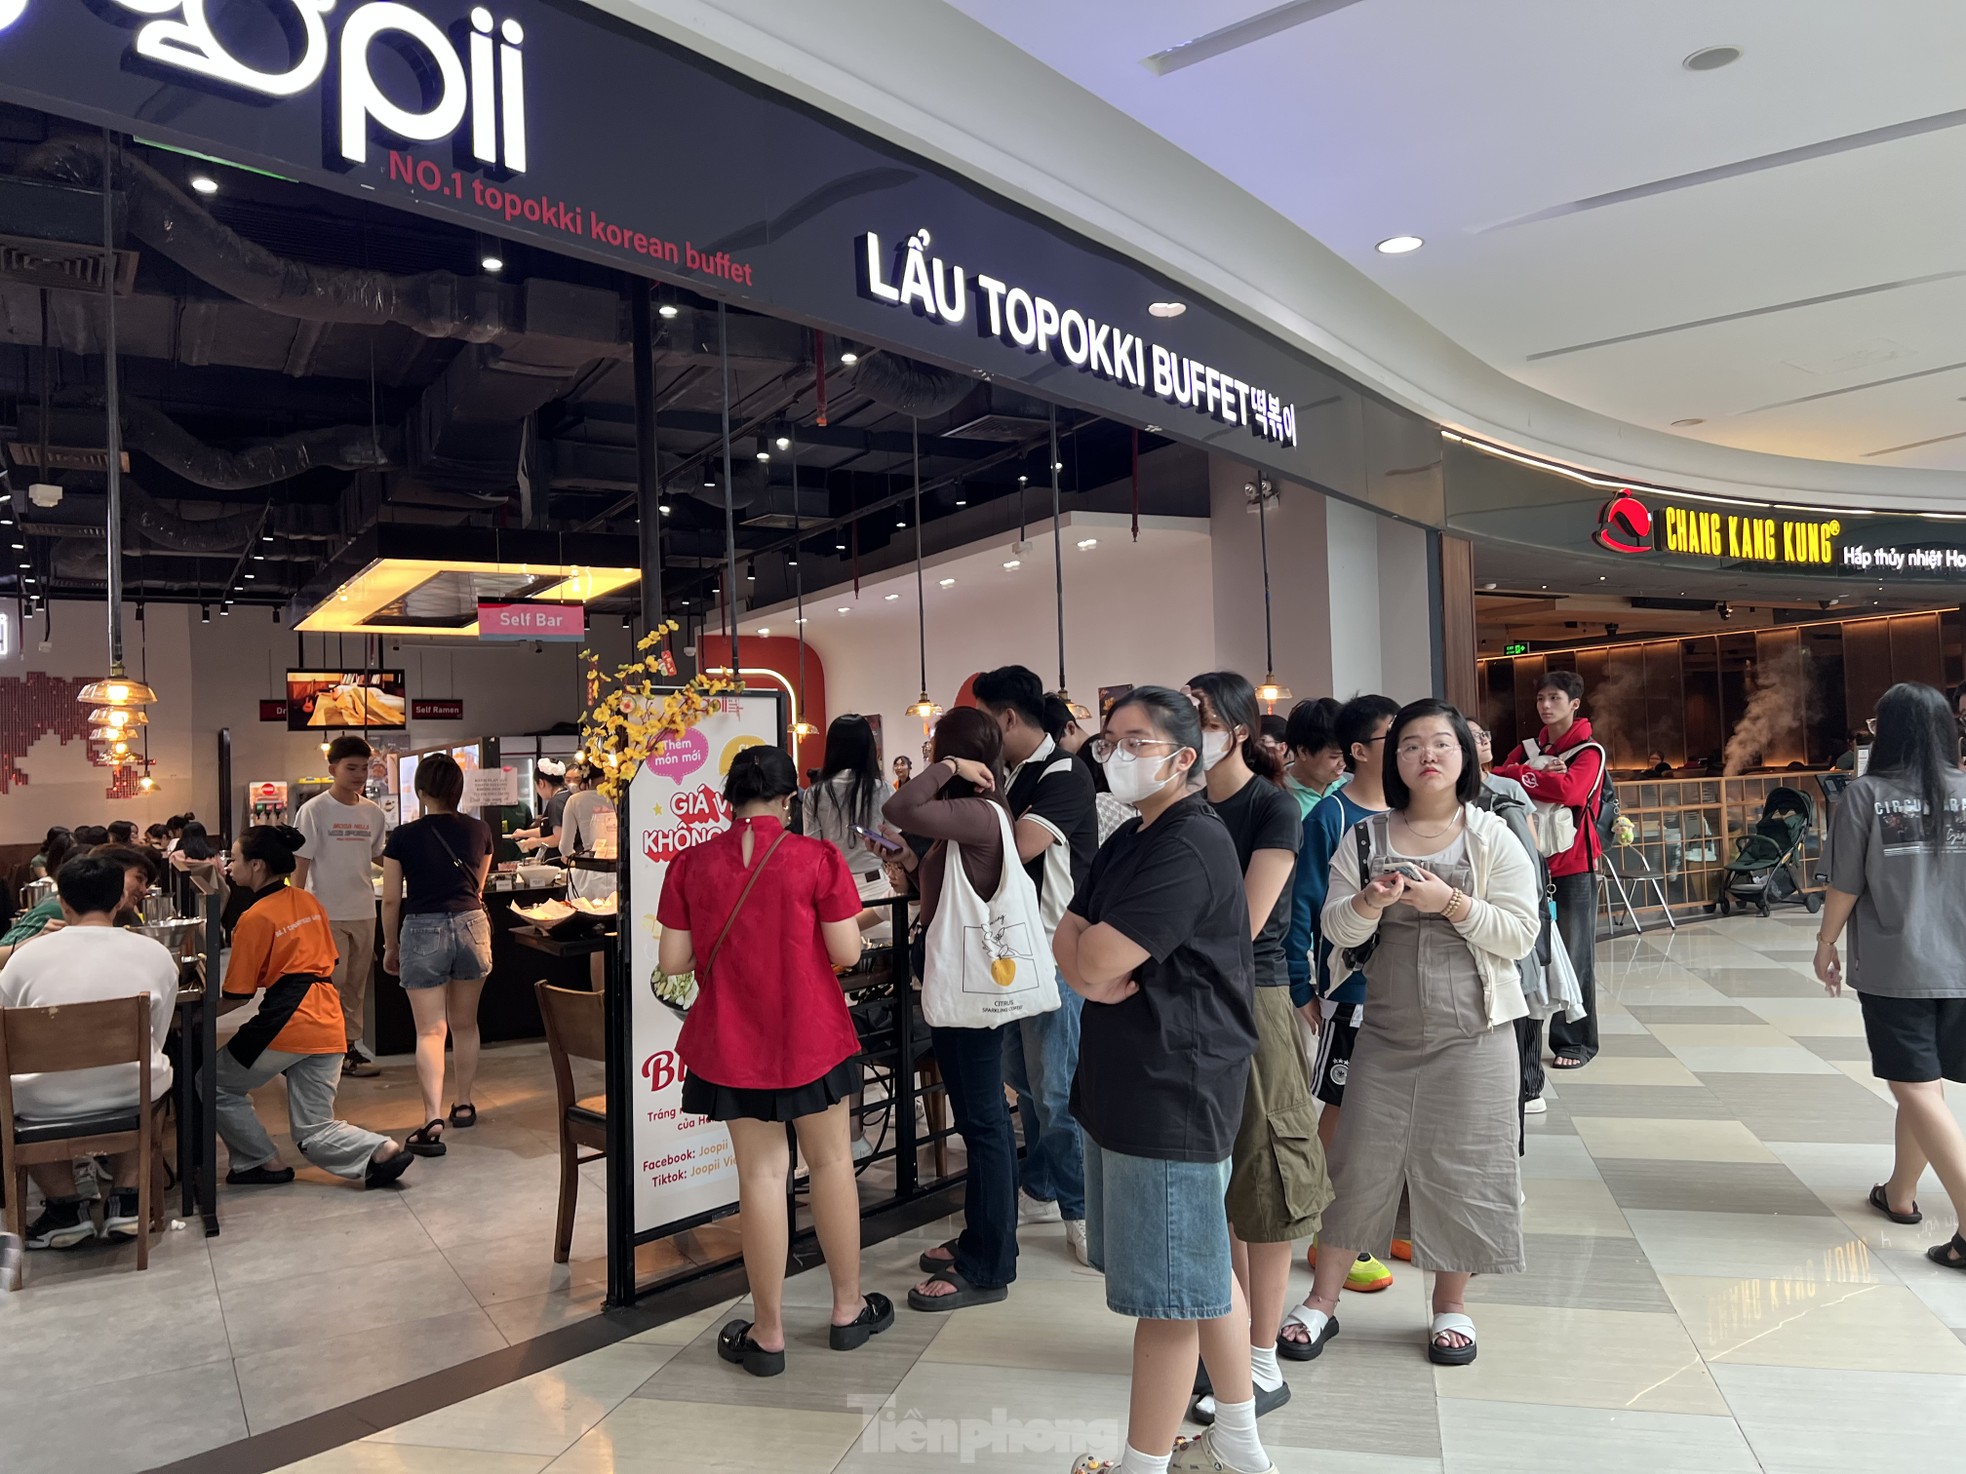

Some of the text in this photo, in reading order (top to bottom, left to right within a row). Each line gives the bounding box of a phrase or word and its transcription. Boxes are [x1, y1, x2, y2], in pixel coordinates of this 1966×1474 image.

[389, 150, 752, 286] NO.1 topokki korean buffet
[866, 227, 967, 323] LẨU
[977, 273, 1146, 387] TOPOKKI
[1151, 343, 1249, 426] BUFFET
[1665, 506, 1721, 556] CHANG
[1728, 515, 1775, 560] KANG
[1843, 545, 1871, 567] Hấp
[1873, 547, 1905, 568] thủy
[1908, 548, 1943, 569] nhiệt
[500, 612, 563, 627] Self Bar
[415, 706, 460, 714] Self Ramen
[655, 751, 701, 766] món mới
[671, 784, 710, 815] GIÁ
[647, 1107, 676, 1122] Tráng
[677, 1117, 695, 1130] của
[643, 1139, 729, 1172] Facebook: Joopii
[652, 1170, 687, 1188] Tiktok:
[690, 1161, 720, 1177] Joopii
